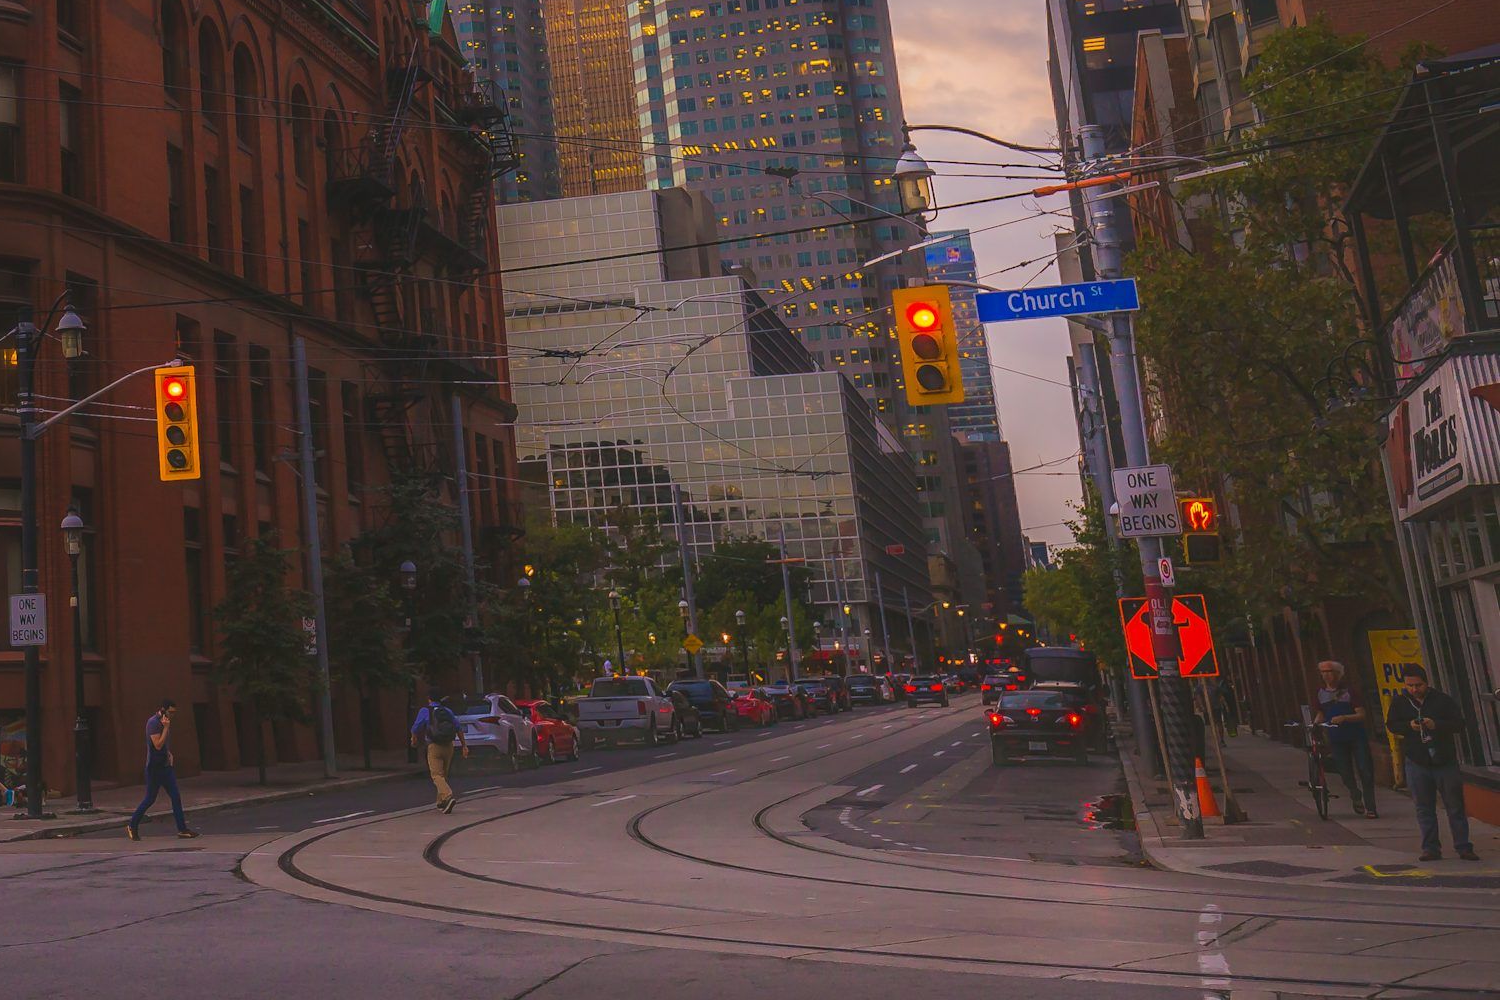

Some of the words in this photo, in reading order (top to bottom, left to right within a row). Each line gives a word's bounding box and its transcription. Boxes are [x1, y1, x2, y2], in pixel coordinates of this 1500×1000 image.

[1007, 287, 1086, 313] Church
[1090, 285, 1103, 297] St
[1413, 414, 1458, 480] WORKS
[1127, 471, 1157, 489] ONE
[1130, 493, 1159, 510] WAY
[1122, 514, 1177, 532] BEGINS
[18, 598, 37, 610] ONE
[19, 613, 37, 625] WAY
[12, 629, 45, 641] BEGINS
